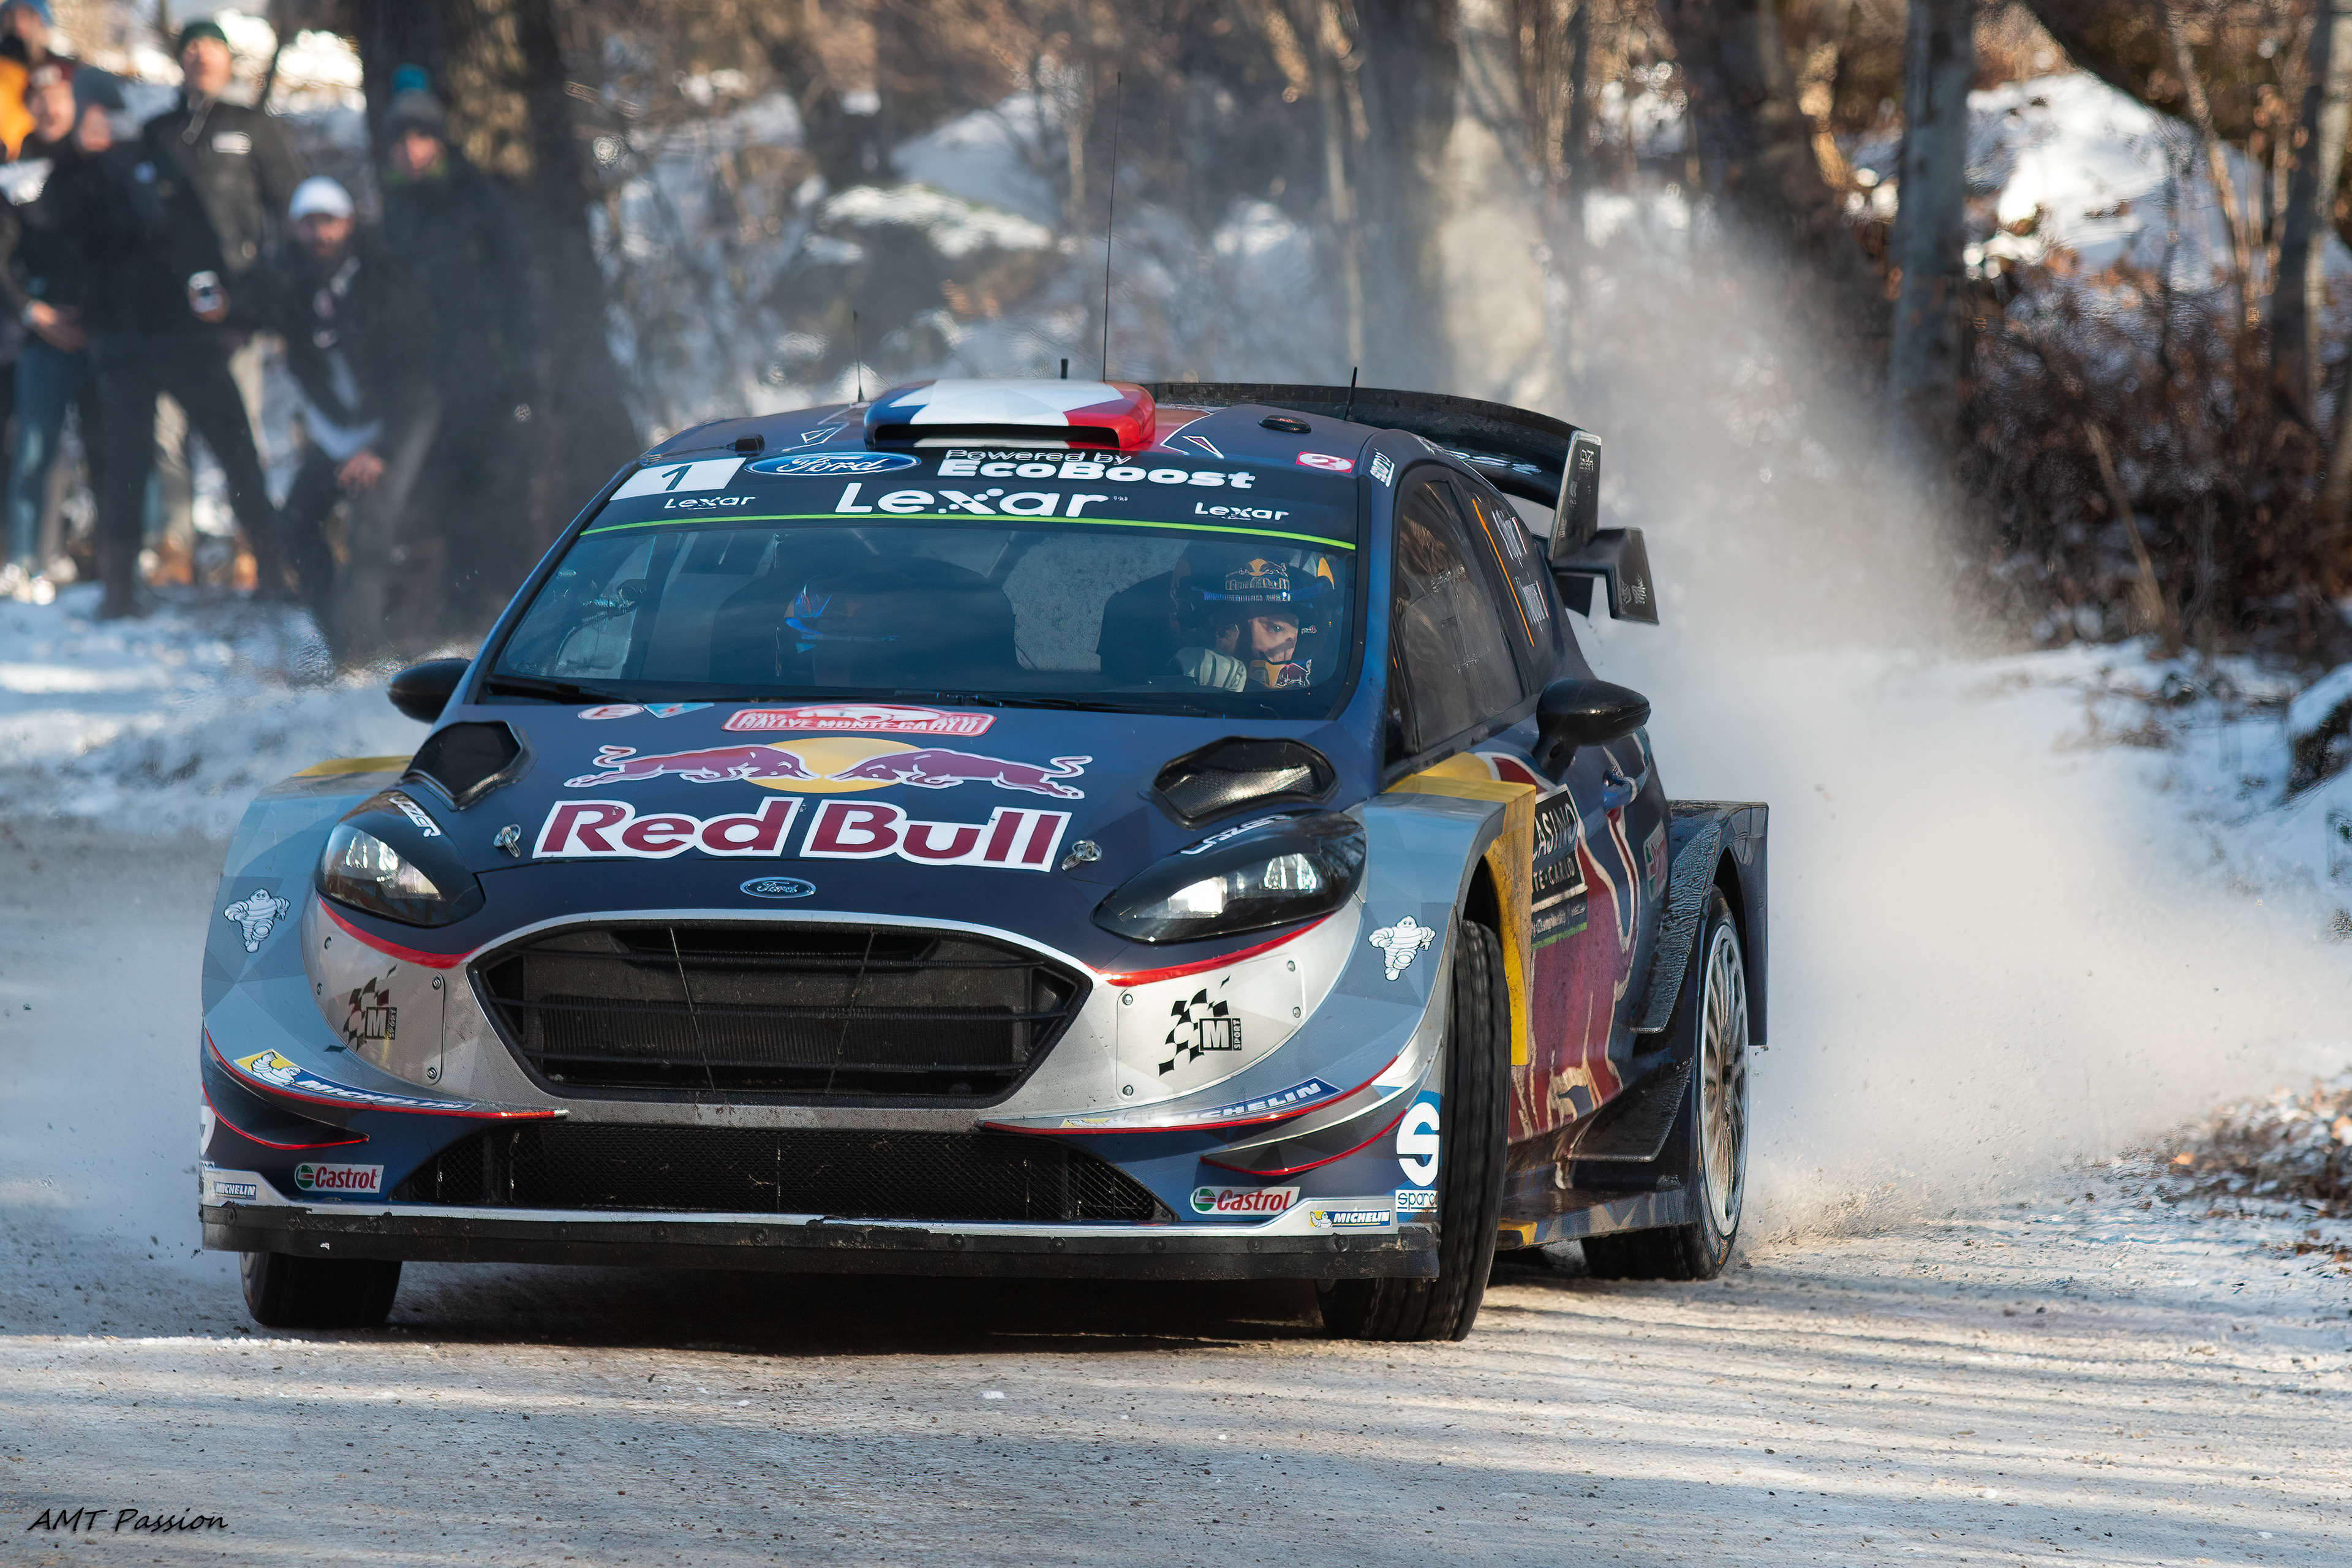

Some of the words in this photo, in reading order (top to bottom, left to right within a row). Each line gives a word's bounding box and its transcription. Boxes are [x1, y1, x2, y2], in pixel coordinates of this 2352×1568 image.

[776, 455, 889, 472] Ford
[945, 450, 1085, 462] Powered
[1094, 452, 1132, 465] by
[662, 464, 693, 491] 1
[938, 459, 1256, 489] EcoBoost
[664, 496, 756, 510] Lexar
[835, 482, 1109, 516] Lexar
[1195, 502, 1289, 521] Lexar
[535, 800, 799, 856] Red
[804, 801, 1068, 867] Bull
[756, 881, 799, 893] Ford
[368, 1009, 388, 1037] M
[1203, 1020, 1229, 1049] M
[1396, 1102, 1440, 1187] S
[314, 1166, 376, 1189] Castrol
[216, 1182, 255, 1196] MICHELIN
[1217, 1190, 1291, 1211] Castrol
[1398, 1193, 1438, 1210] sparc
[1333, 1212, 1390, 1223] MICHELIN
